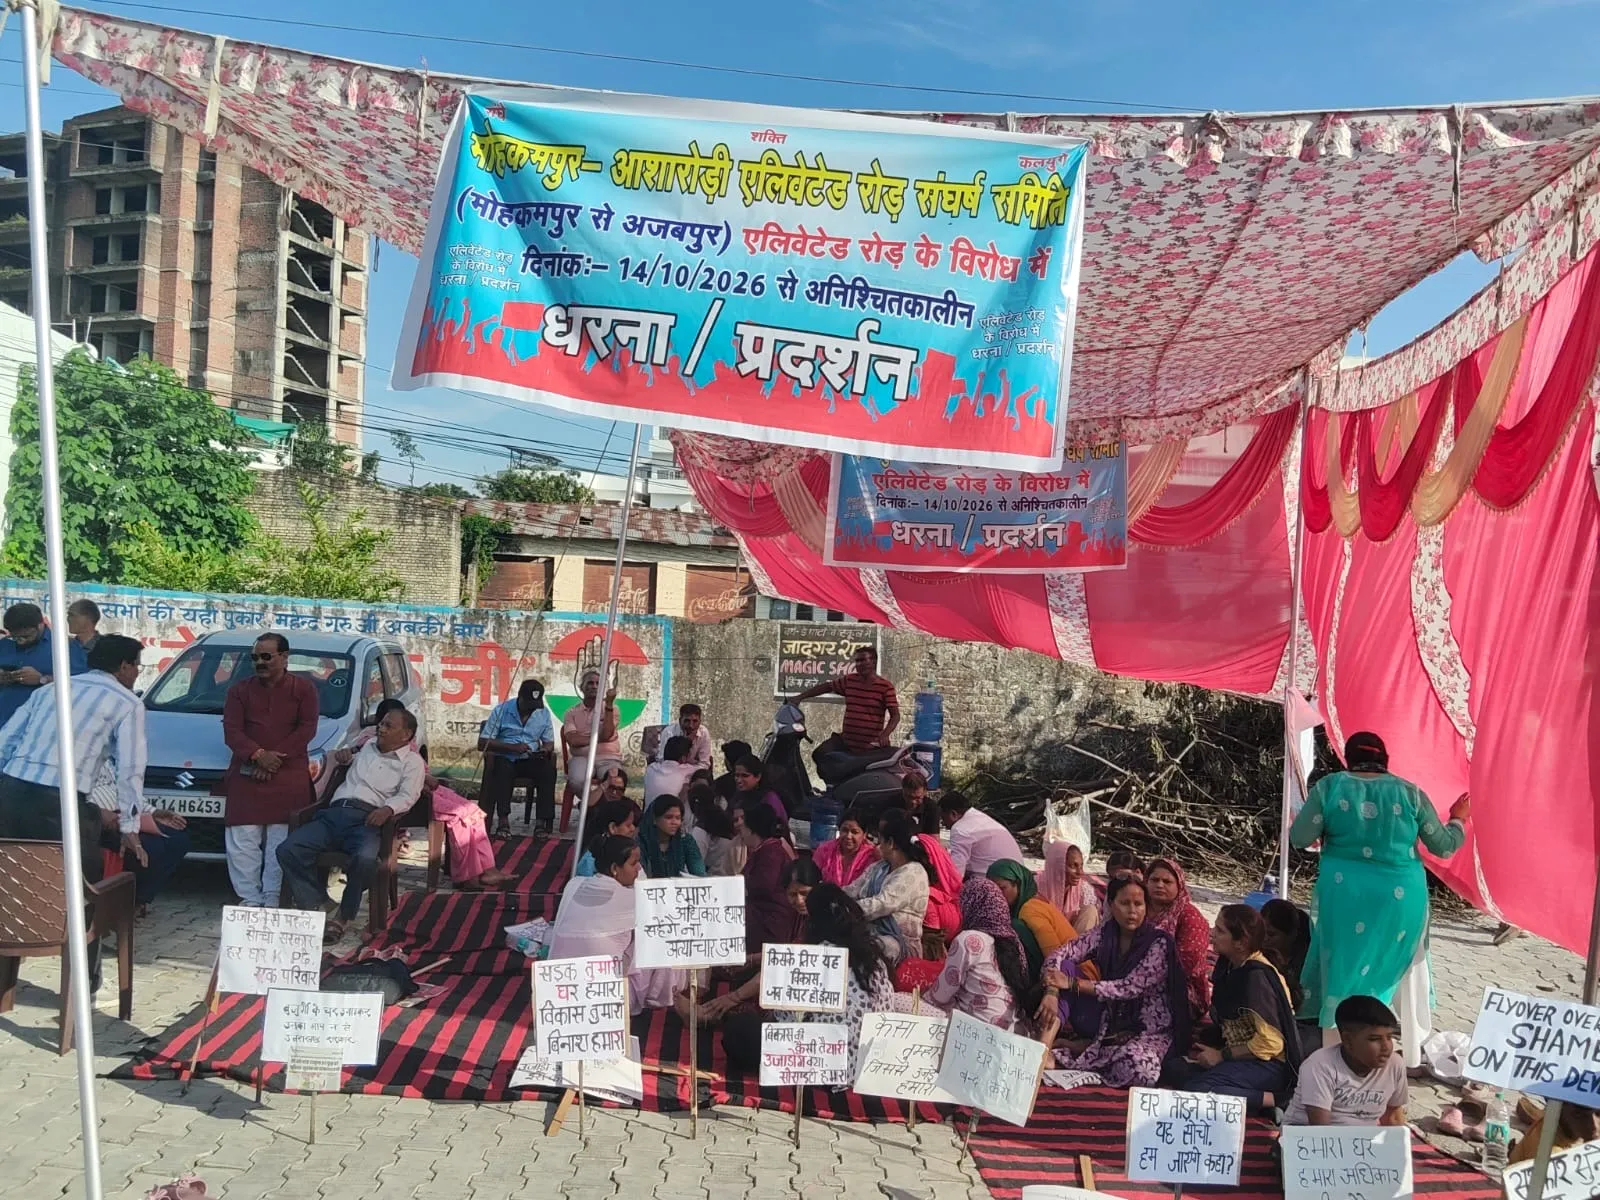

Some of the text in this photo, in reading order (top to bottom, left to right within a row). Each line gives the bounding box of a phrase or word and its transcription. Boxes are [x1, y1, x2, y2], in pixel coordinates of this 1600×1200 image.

[751, 130, 787, 145] शक्ति
[610, 140, 733, 203] आशारोड़ी
[738, 148, 851, 210] एलिवेटेड
[856, 158, 908, 223] रोड़
[913, 170, 987, 217] संघर्ष
[990, 171, 1069, 229] समिति
[456, 185, 1053, 282] (मोहकमपुर से अजबपुर) एलिवेटेड रोड़ के विरोध में
[449, 242, 491, 257] एलिवेटेड
[452, 260, 461, 270] के
[465, 259, 494, 272] विरोध
[440, 274, 467, 286] धरना
[481, 276, 520, 292] प्रदर्शन
[619, 253, 765, 297] 14/10/2026
[777, 269, 799, 300] से
[805, 274, 974, 329] अनिश्चितकालीन
[979, 311, 1023, 328] एलिवेटेड
[984, 331, 994, 343] के
[999, 325, 1027, 340] विरोध
[543, 303, 677, 366] धरना
[734, 319, 919, 401] प्रदर्शन
[972, 346, 1002, 359] धरना
[1016, 339, 1056, 359] प्रदर्शन
[872, 469, 947, 491] एलिवेटेड
[953, 473, 987, 495] रोड़
[993, 473, 1012, 492] के
[1018, 472, 1071, 492] विरोध
[924, 495, 993, 512] 14/10/2026
[998, 496, 1007, 512] से
[1011, 493, 1088, 512] अनिश्चितकालीन
[891, 520, 954, 547] धरना
[982, 513, 1066, 549] प्रदर्शन
[148, 600, 174, 621] की
[384, 614, 444, 636] अबकी
[782, 640, 837, 659] जादूगर
[780, 659, 826, 674] MAGIC
[644, 886, 667, 904] घर
[767, 948, 842, 969] किसके लिए यह
[281, 965, 318, 985] परिवार
[555, 984, 579, 1001] घर
[539, 1000, 587, 1026] विकास
[1484, 991, 1557, 1026] FLYOVER
[1468, 1046, 1508, 1072] ON
[1513, 1055, 1558, 1083] THIS
[1140, 1093, 1159, 1117] घर
[1206, 1096, 1218, 1121] से
[1156, 1121, 1175, 1144] यह
[1140, 1147, 1158, 1171] हम
[1296, 1135, 1376, 1160] हमारा घर
[1340, 1162, 1402, 1185] अधिकार
